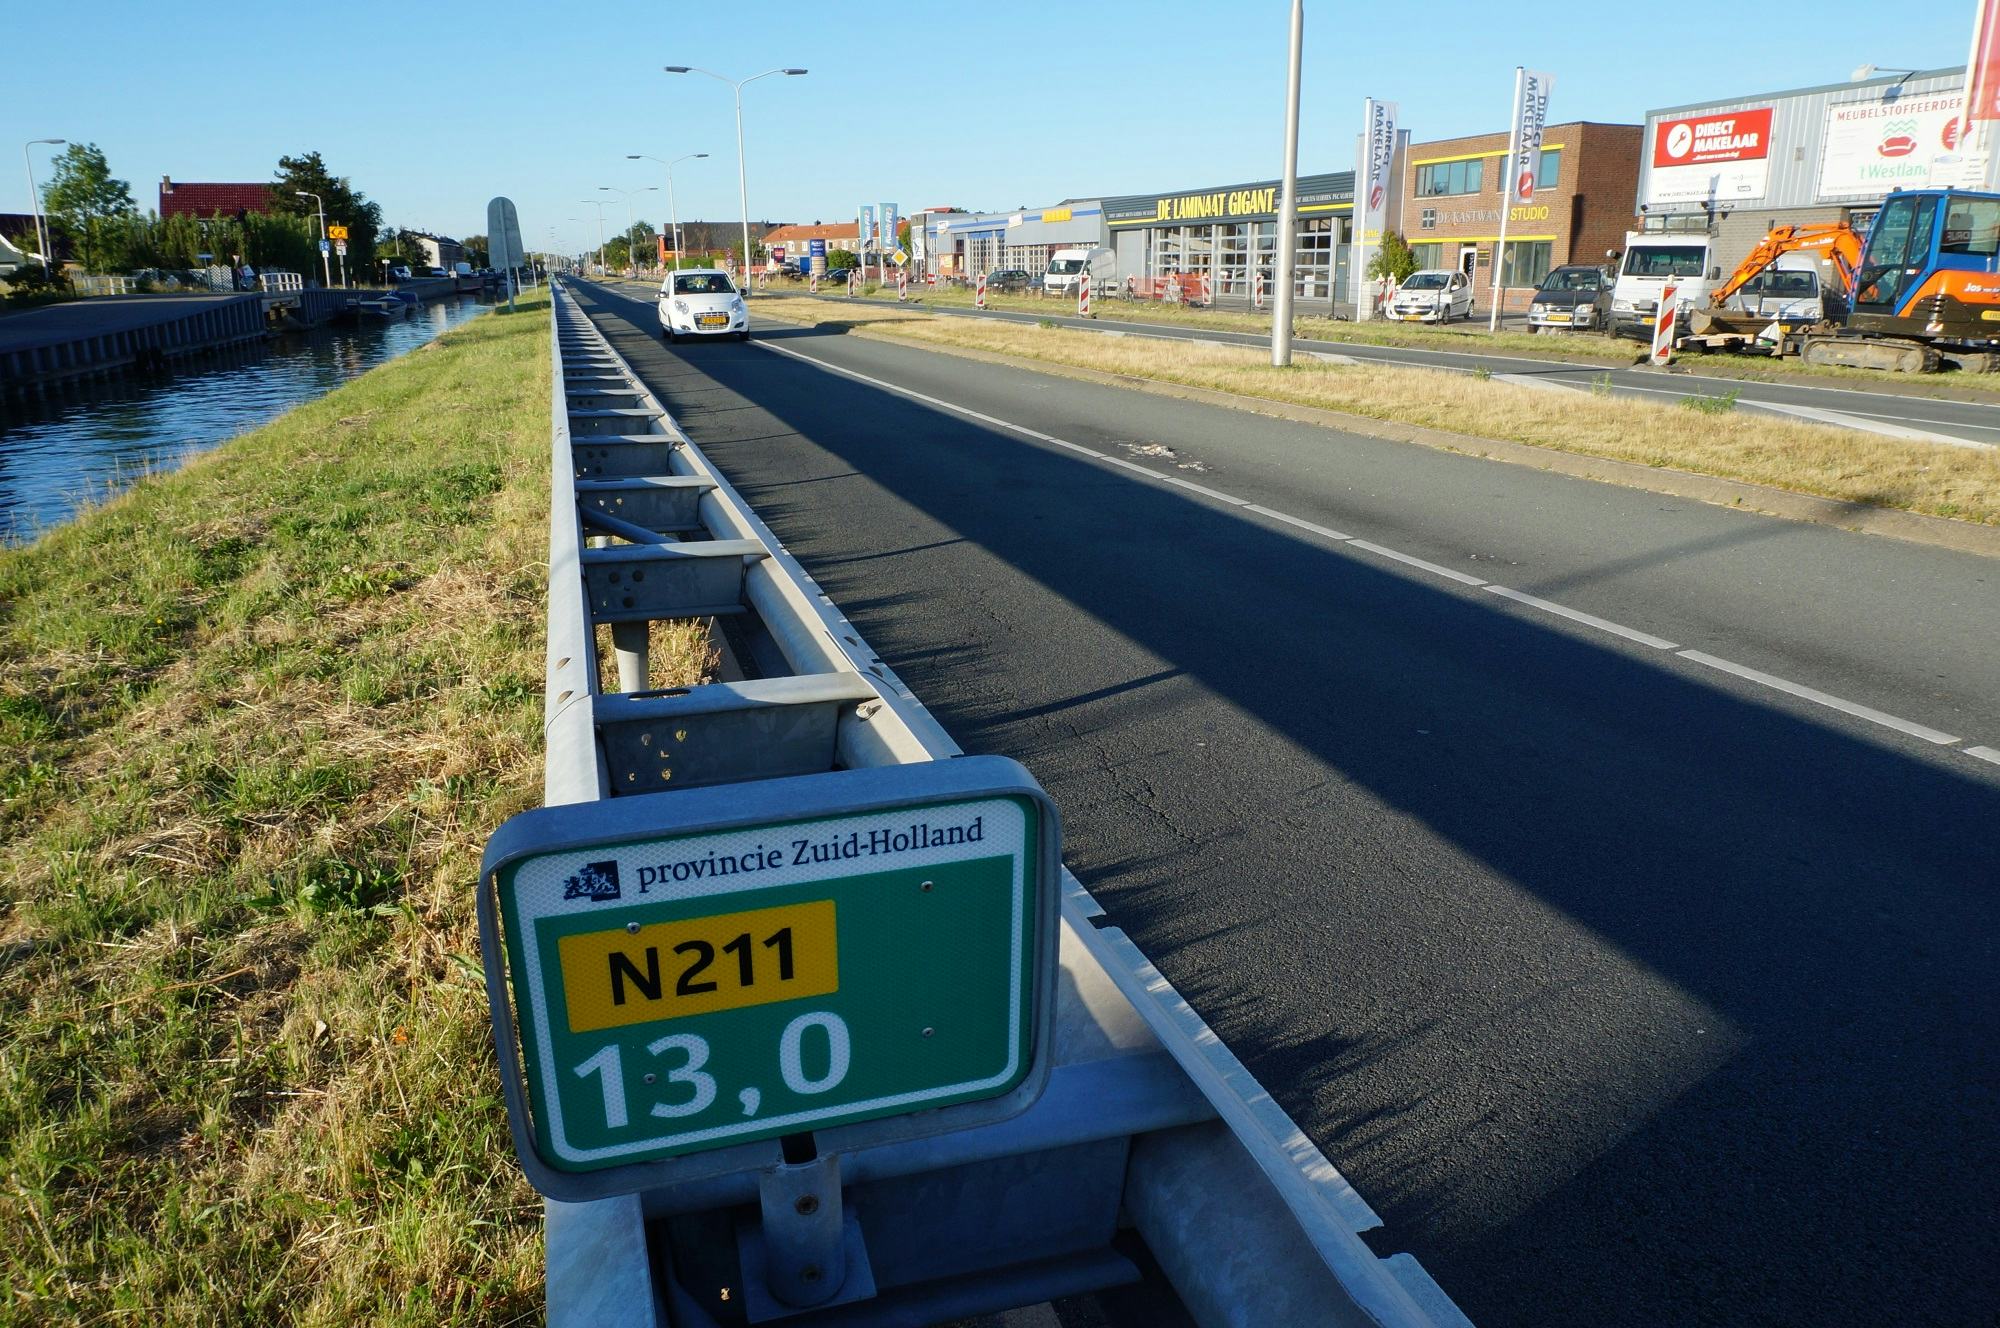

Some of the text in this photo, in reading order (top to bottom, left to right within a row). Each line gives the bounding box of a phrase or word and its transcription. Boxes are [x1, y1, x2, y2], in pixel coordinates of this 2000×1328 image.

[1372, 104, 1384, 181] MAKELAAR
[1383, 120, 1393, 167] DIRECT
[1520, 76, 1538, 166] MAKELAAR
[1533, 95, 1547, 148] DIRECT
[1693, 132, 1759, 153] MAKELAAR
[1695, 119, 1736, 138] DIRECT
[1157, 188, 1275, 221] DE LAMINAAT GIGANT
[1510, 206, 1549, 221] STUDIO
[635, 816, 985, 894] provincie Zuid-Holland
[608, 927, 795, 1006] N211
[572, 1011, 852, 1130] 13,0
